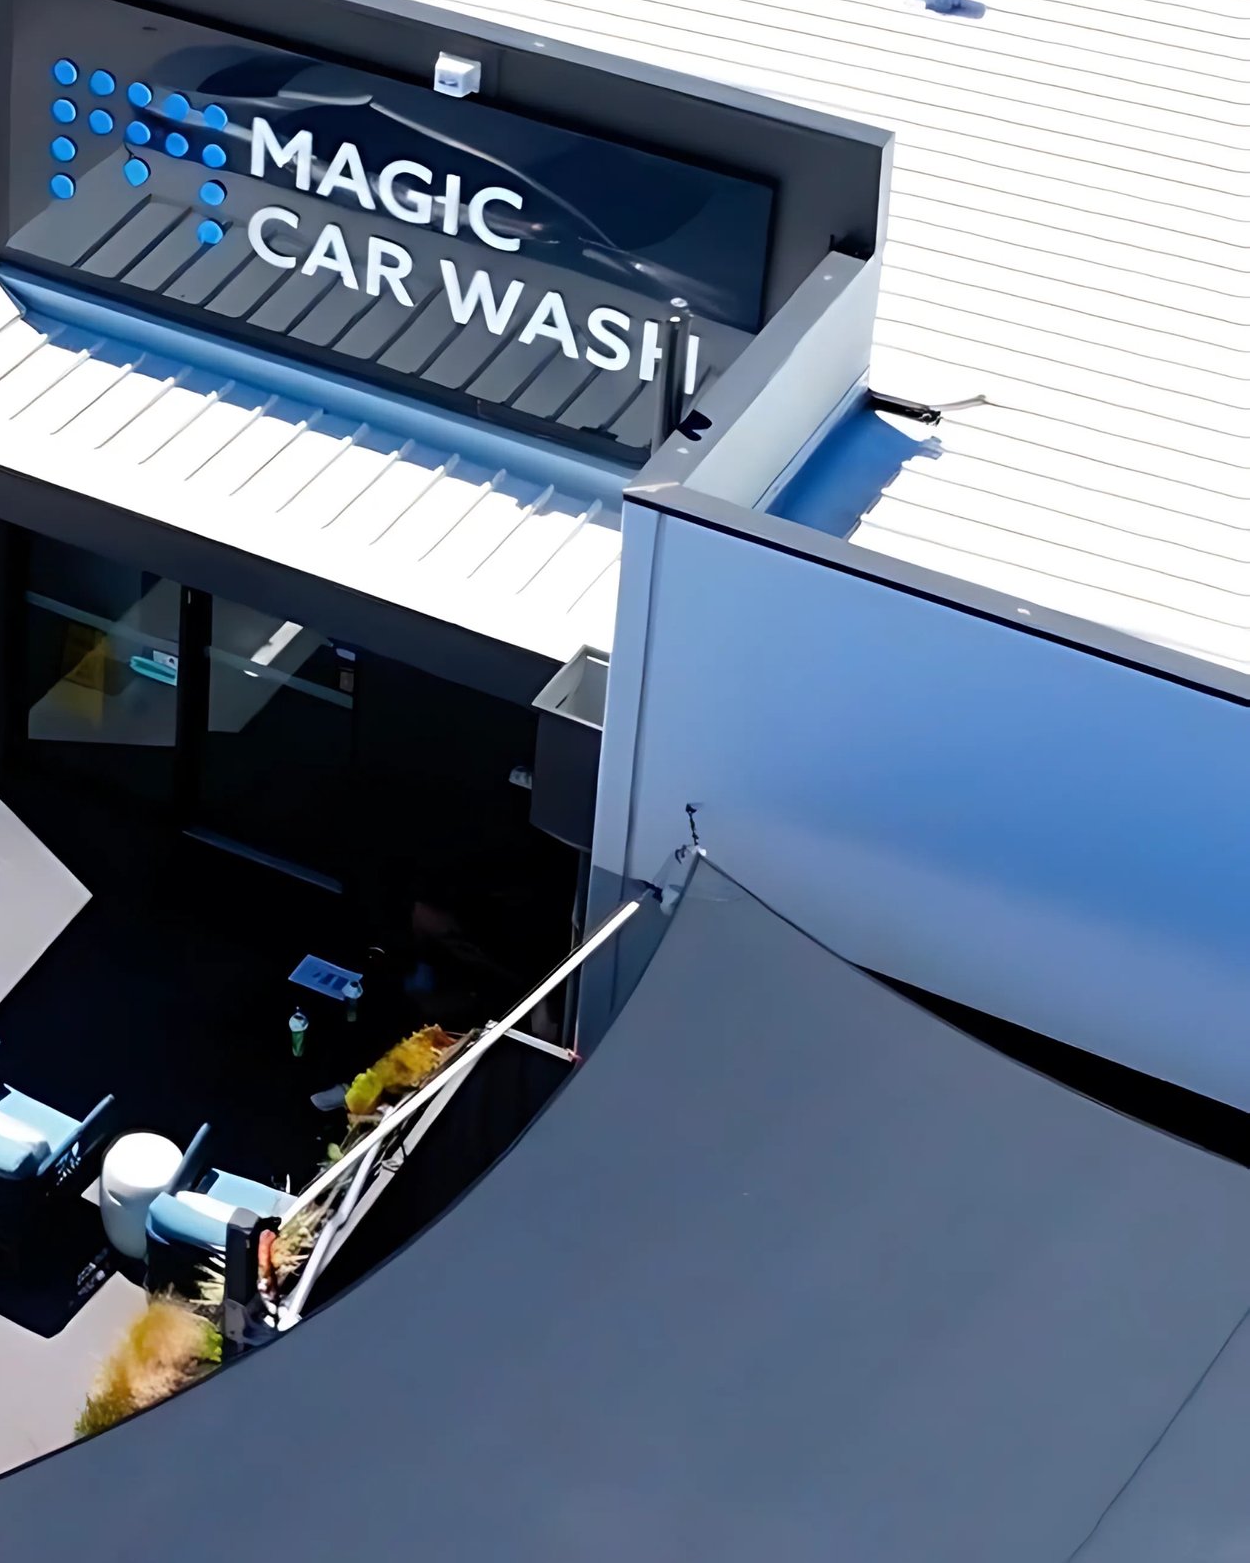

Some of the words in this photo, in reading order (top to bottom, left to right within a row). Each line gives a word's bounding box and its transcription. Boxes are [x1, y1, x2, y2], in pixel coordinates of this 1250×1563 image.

[250, 116, 524, 252] MAGIC
[247, 205, 415, 308] CAR
[439, 258, 700, 395] WASH
